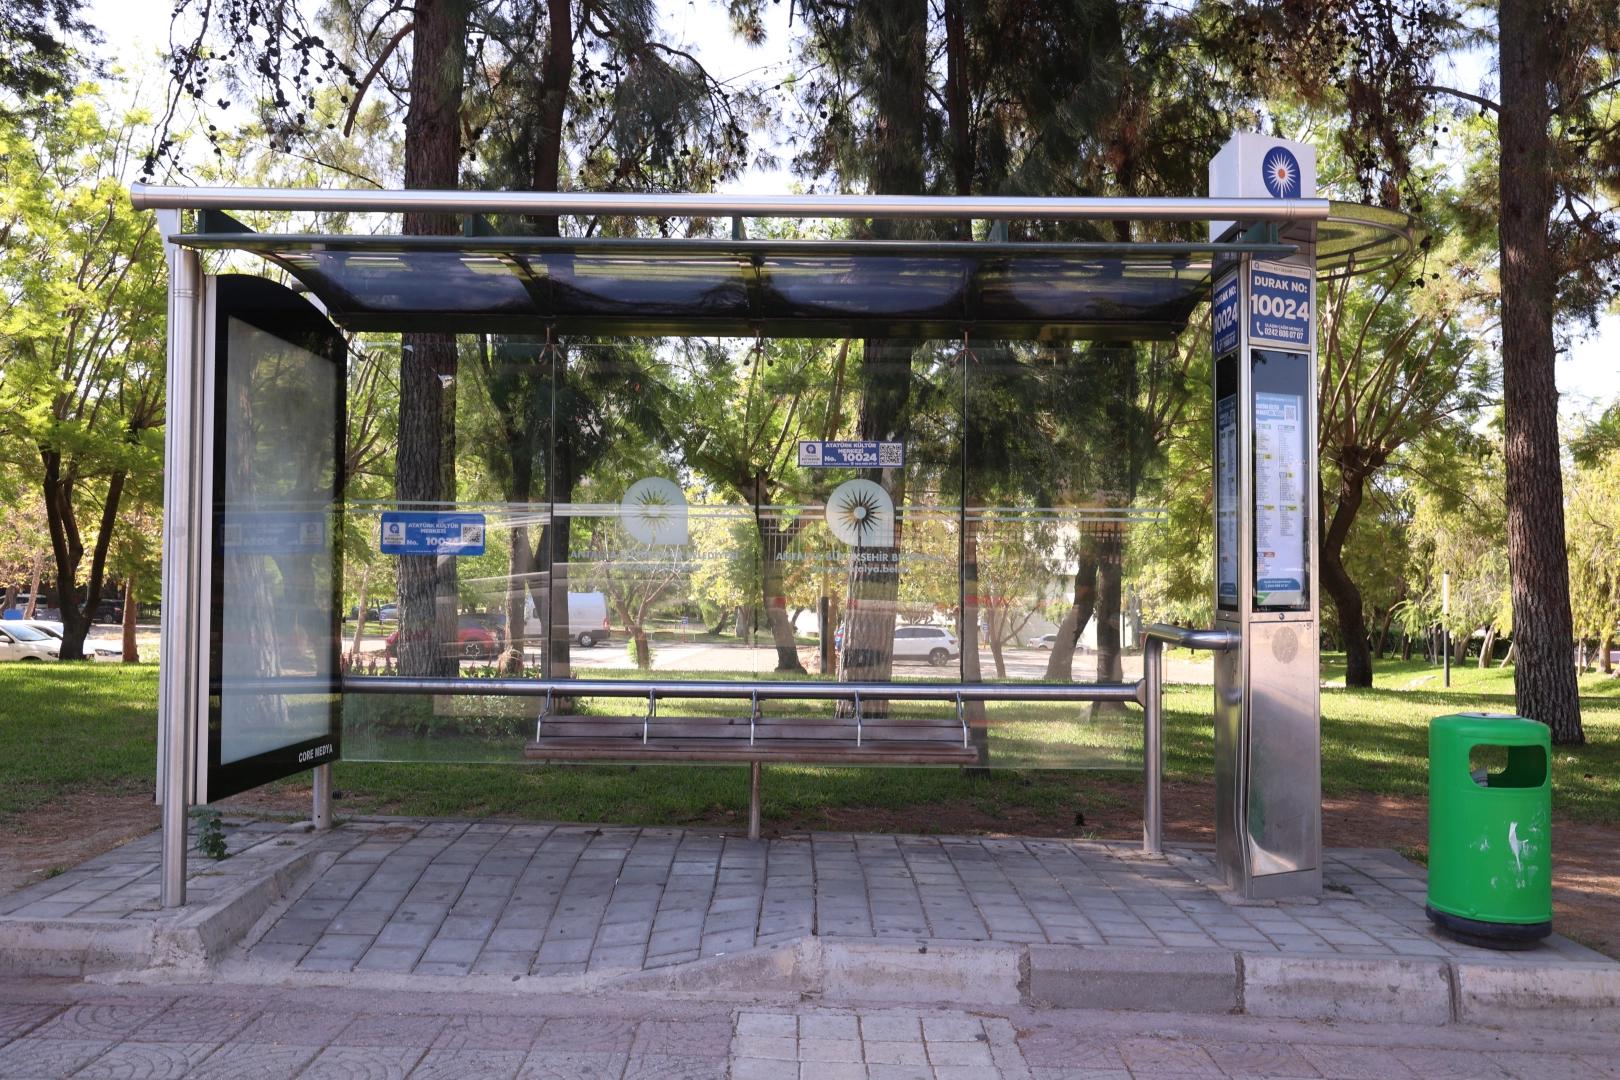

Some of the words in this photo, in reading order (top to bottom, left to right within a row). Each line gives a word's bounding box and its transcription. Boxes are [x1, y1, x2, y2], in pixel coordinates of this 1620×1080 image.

[1254, 275, 1289, 291] DURAK
[1291, 281, 1308, 294] NO:
[1215, 290, 1229, 308] DURAK
[1250, 293, 1310, 322] 10024
[1214, 301, 1239, 335] 10024
[1264, 327, 1279, 337] 0242
[1289, 331, 1297, 339] 07
[1297, 332, 1304, 340] 07
[842, 453, 877, 462] 10024
[776, 552, 822, 561] ANTALYA
[298, 748, 314, 763] CORE
[314, 744, 333, 758] MEDYA
